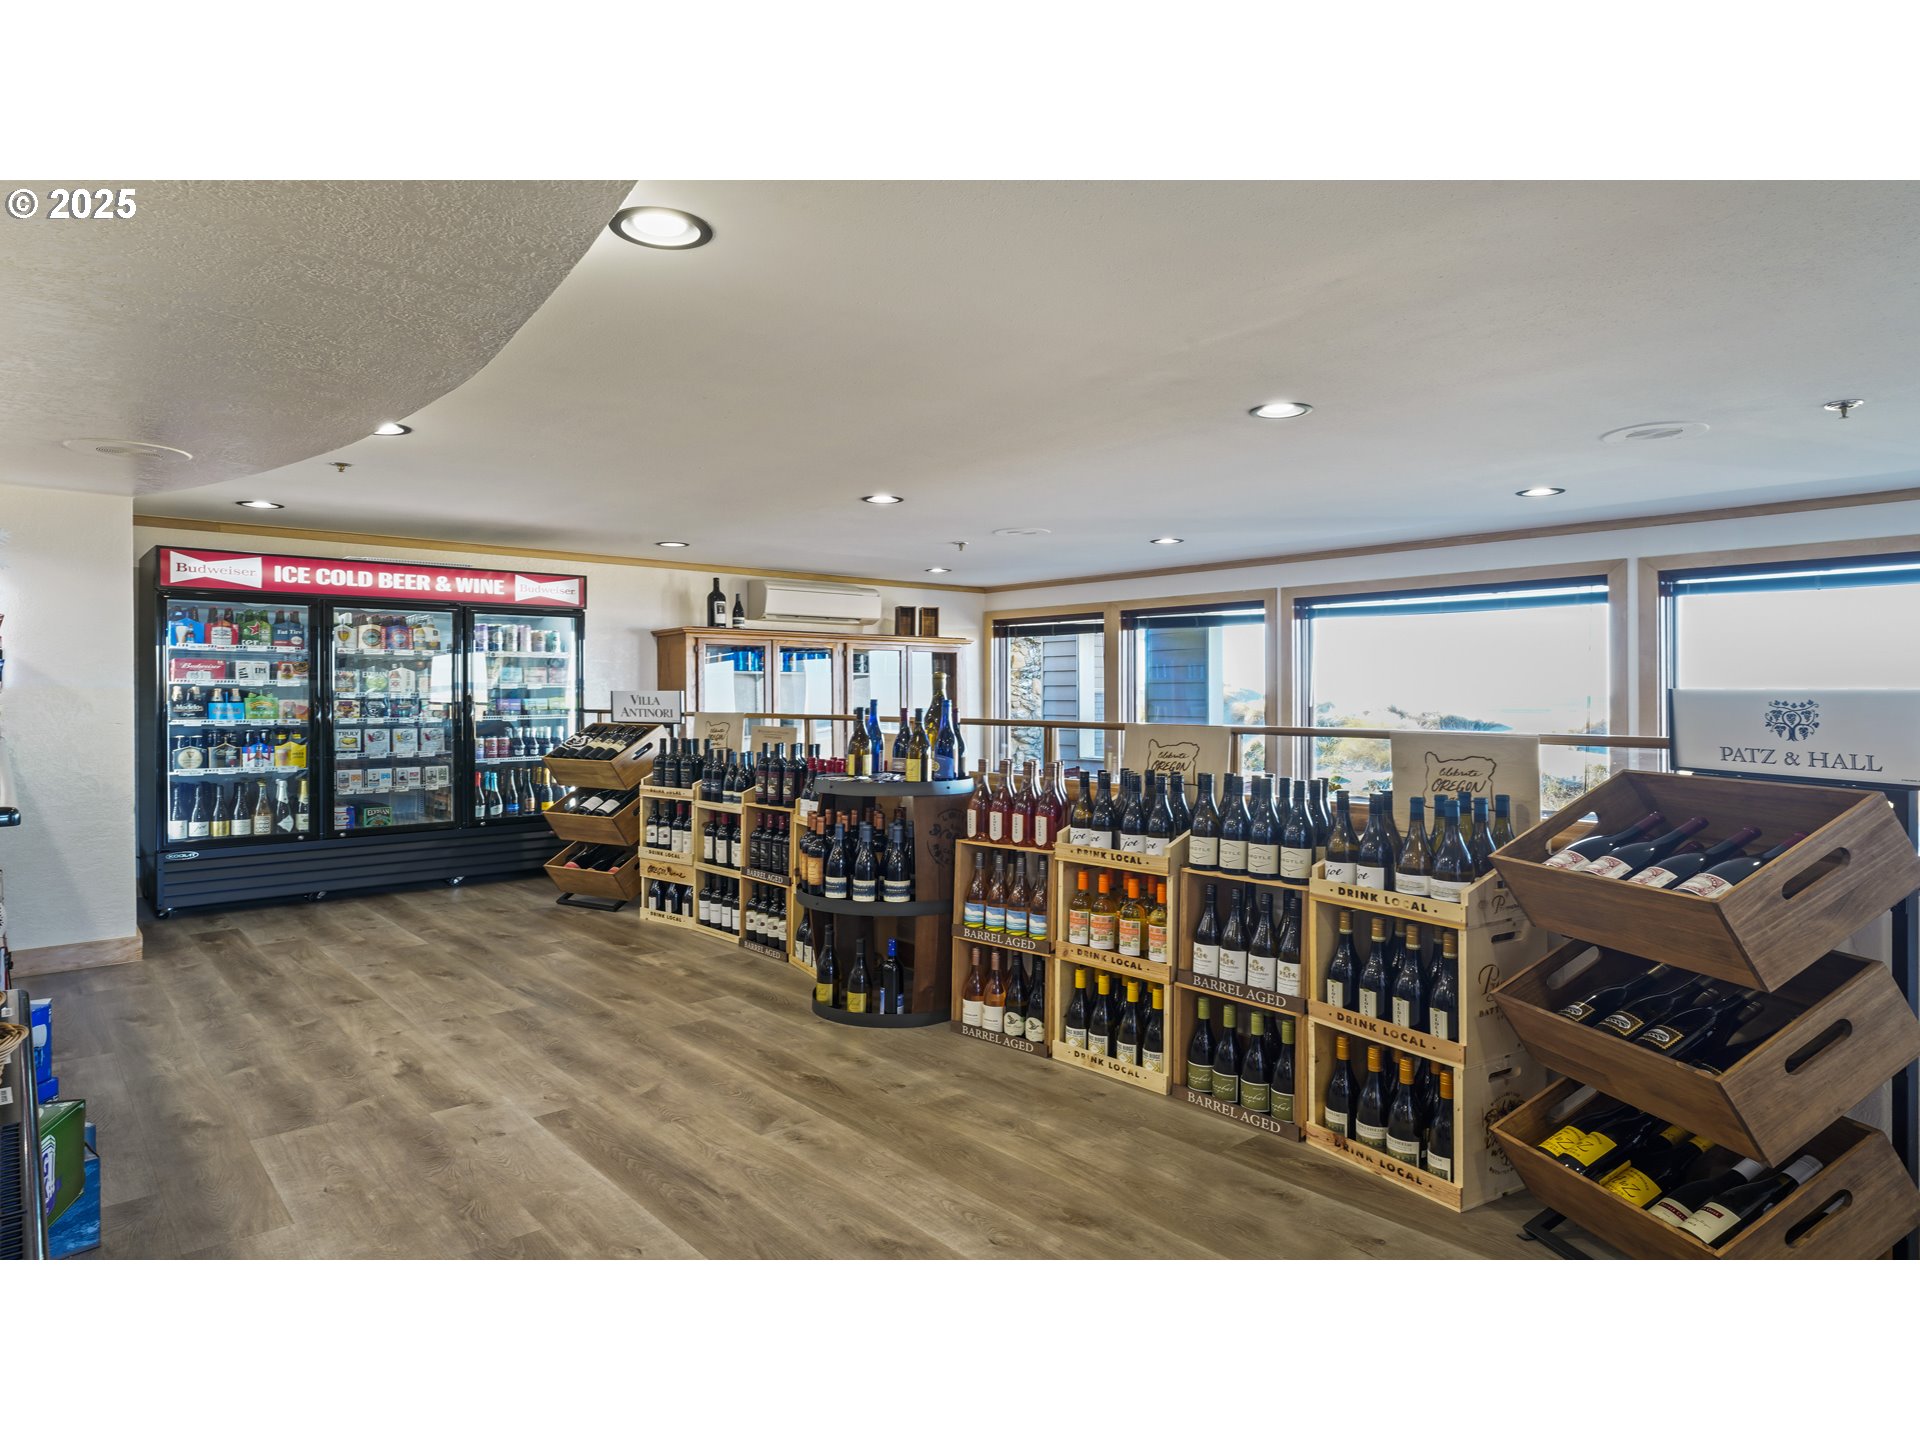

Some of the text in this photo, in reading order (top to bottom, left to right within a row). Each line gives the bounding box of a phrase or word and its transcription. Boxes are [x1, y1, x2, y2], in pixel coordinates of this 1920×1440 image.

[175, 562, 257, 577] Budweiser
[274, 565, 505, 595] ICE COLD BEER & WINE
[519, 583, 577, 596] Budweiser
[181, 662, 221, 670] Budweiser
[630, 694, 661, 706] VILLA
[620, 707, 673, 718] ANTINORI
[1152, 760, 1191, 772] OREGON
[1720, 746, 1883, 772] PATZ & HALL
[1431, 778, 1487, 793] OREGON
[1076, 848, 1142, 865] DRINK LOCAL
[746, 868, 783, 884] BARREL AGED
[1338, 886, 1428, 913] DRINK LOCAL
[744, 940, 781, 959] BARREL AGED
[963, 928, 1036, 950] BARREL AGED
[1077, 948, 1143, 971] DRINK LOCAL
[1192, 975, 1287, 1008] BARREL AGED
[962, 1025, 1034, 1053] BARREL AGED
[1337, 1012, 1426, 1048] DRINK LOCAL
[1074, 1050, 1140, 1078] DRINK LOCAL
[1187, 1091, 1281, 1133] BARREL AGED
[1334, 1136, 1423, 1185] DRINK LOCAL
